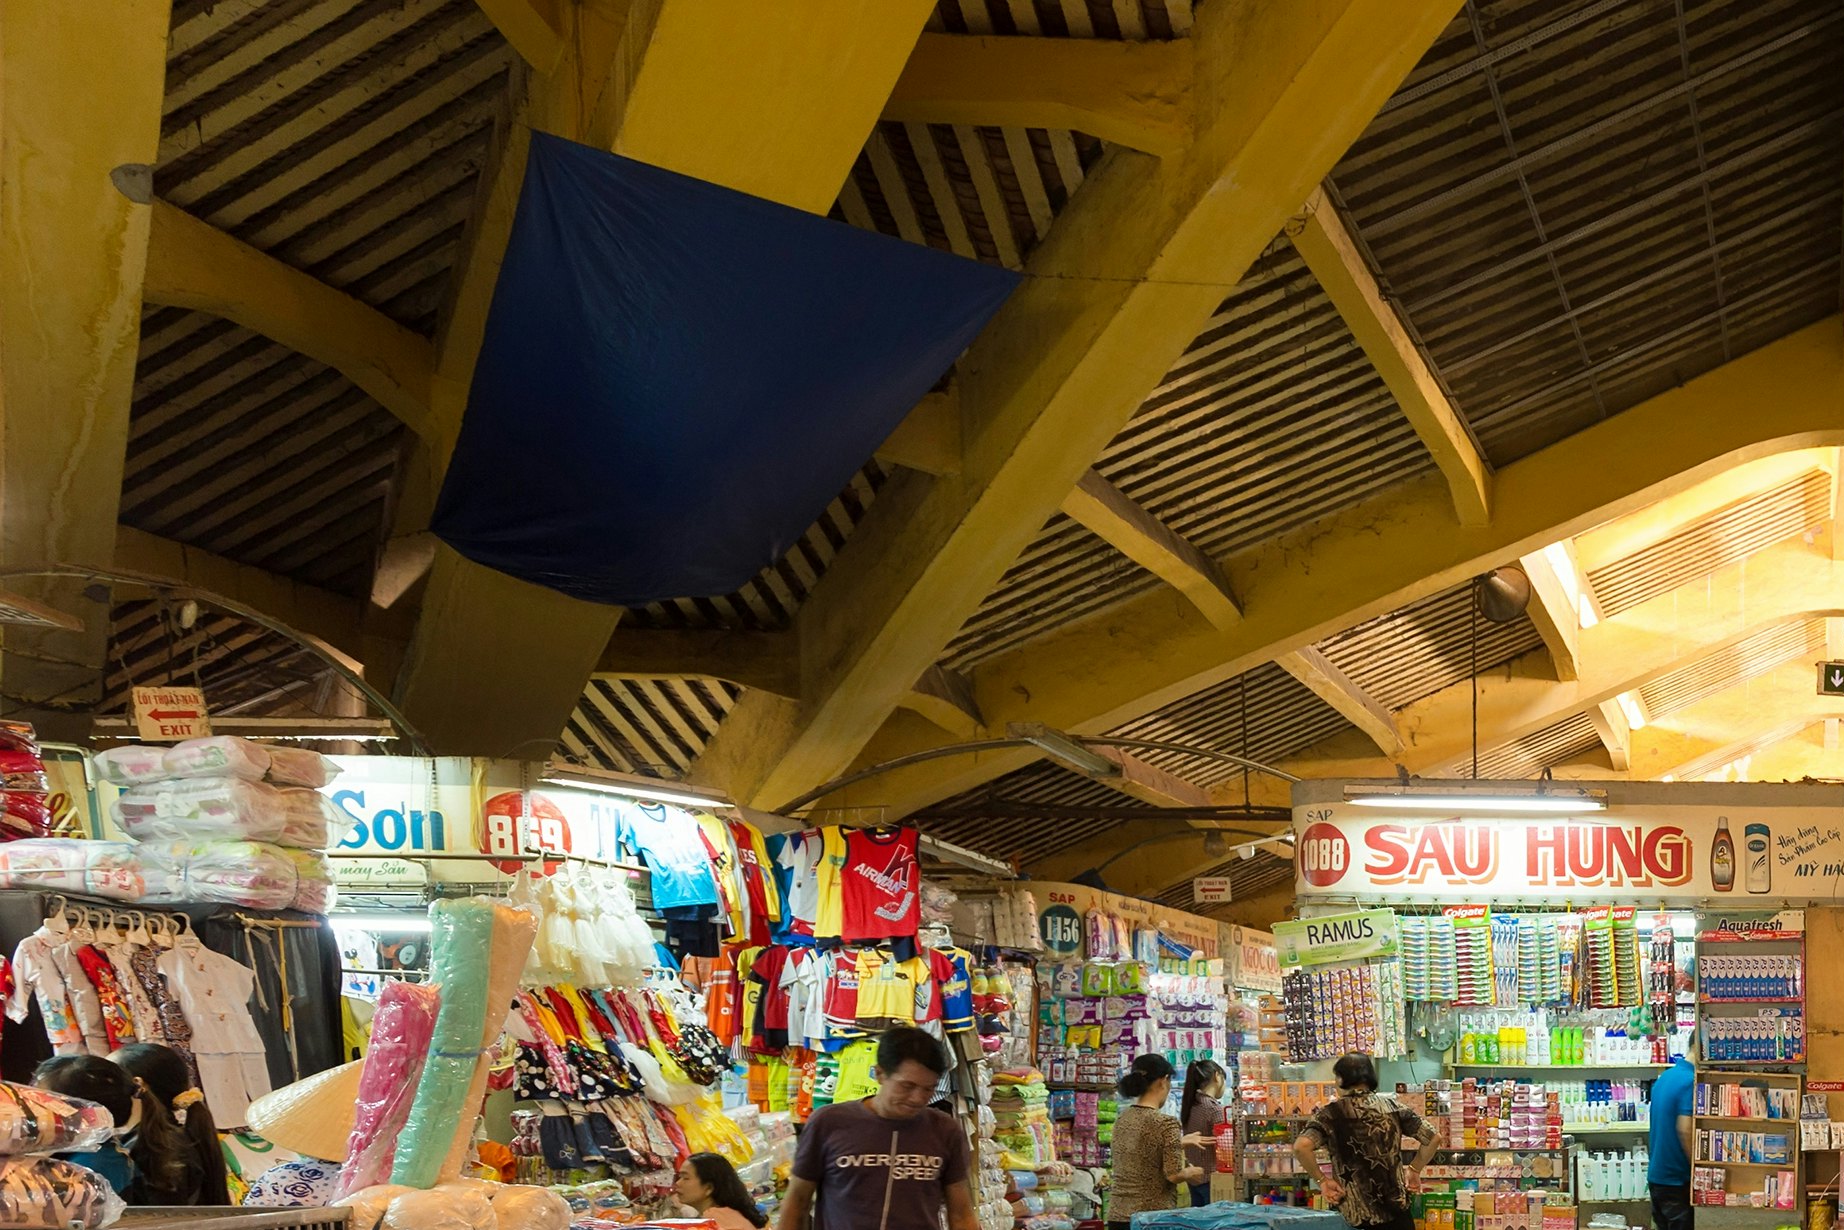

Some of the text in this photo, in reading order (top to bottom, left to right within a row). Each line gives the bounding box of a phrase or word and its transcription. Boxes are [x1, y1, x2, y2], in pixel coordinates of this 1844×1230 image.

[159, 724, 192, 736] EXIT
[1306, 808, 1333, 823] SAP
[1303, 838, 1345, 872] 1088
[853, 862, 904, 893] AIRMAN
[1049, 892, 1075, 903] SAP
[1444, 906, 1485, 919] Colgate
[1307, 918, 1374, 945] RAMUS
[1718, 918, 1783, 933] Aquafresh
[1807, 1081, 1843, 1091] Colgate
[836, 1153, 892, 1168] OVER
